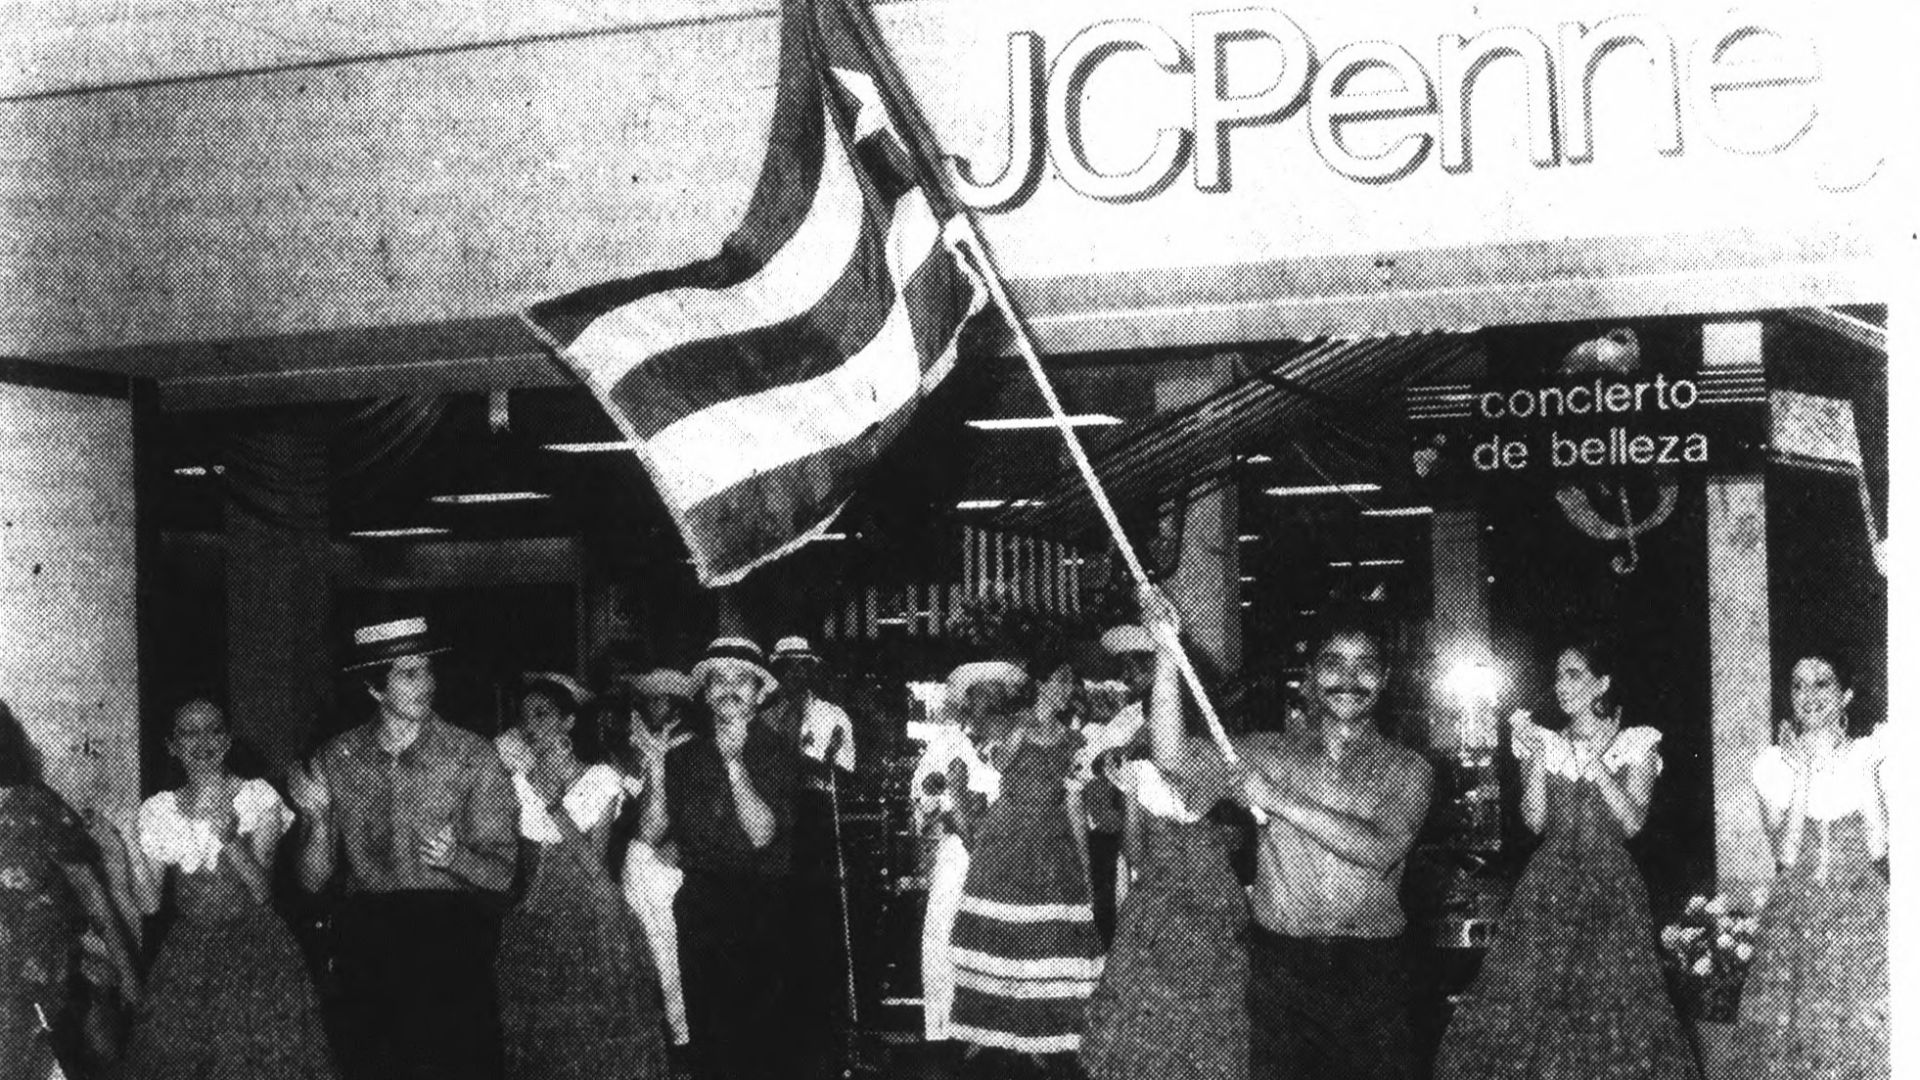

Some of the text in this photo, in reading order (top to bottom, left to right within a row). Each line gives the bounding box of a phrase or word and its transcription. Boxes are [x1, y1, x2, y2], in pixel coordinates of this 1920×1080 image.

[944, 7, 1885, 214] JCPenne
[1480, 372, 1698, 418] concierto
[1472, 427, 1708, 470] de belleza
